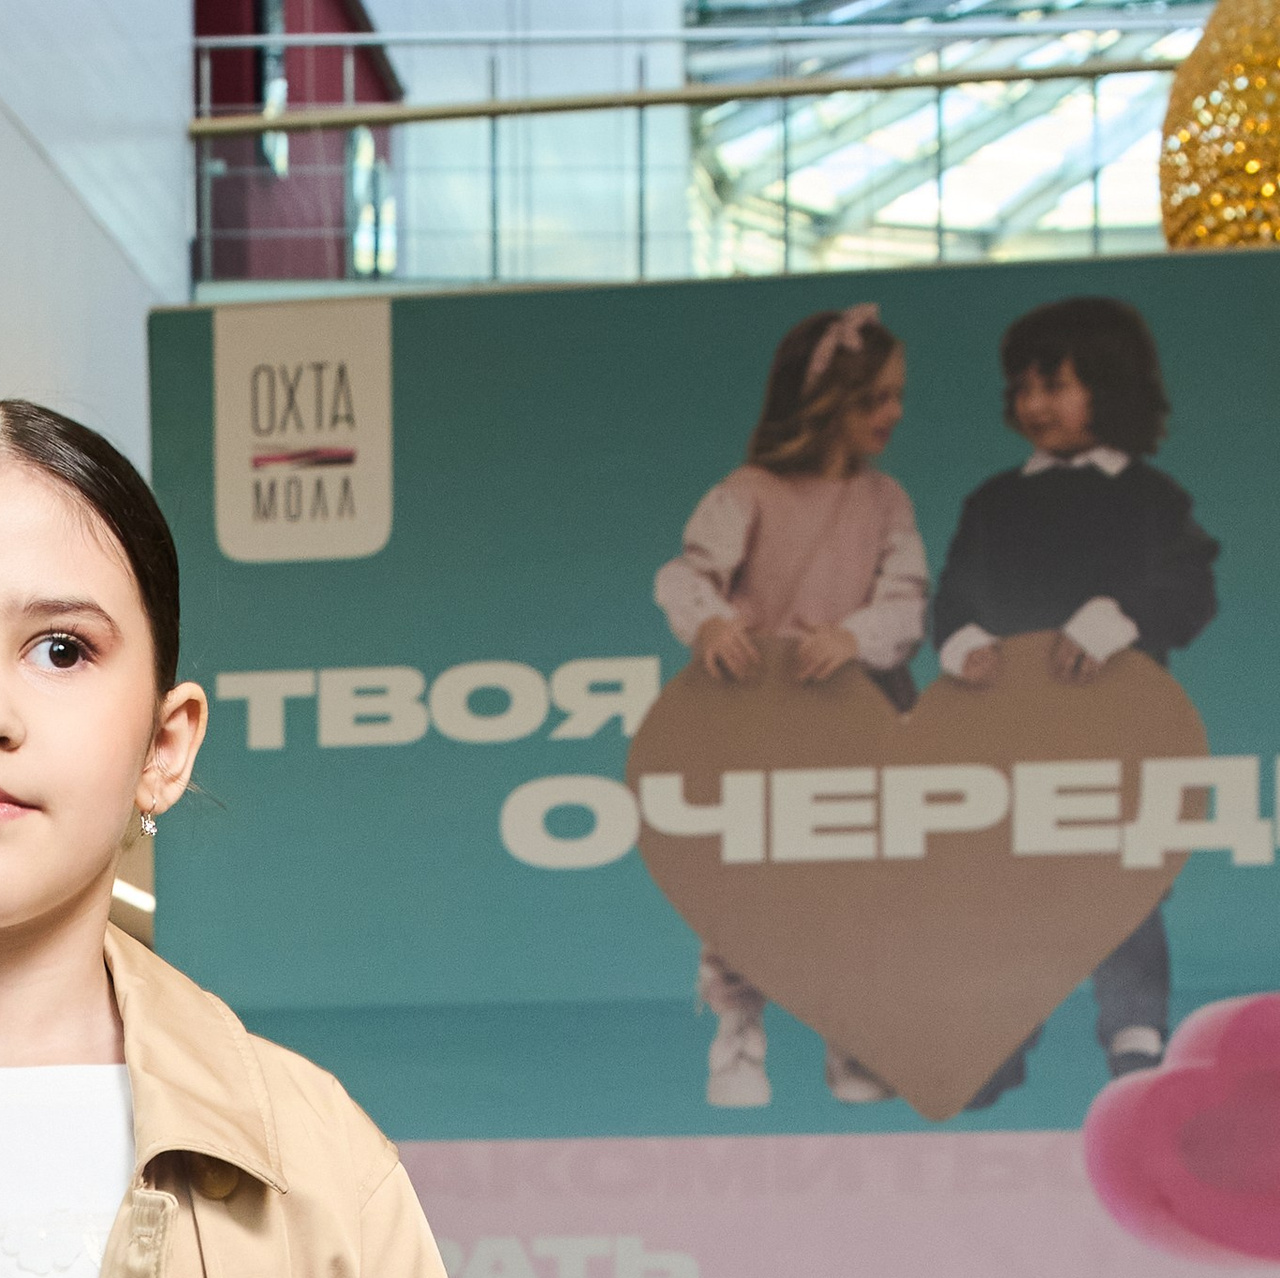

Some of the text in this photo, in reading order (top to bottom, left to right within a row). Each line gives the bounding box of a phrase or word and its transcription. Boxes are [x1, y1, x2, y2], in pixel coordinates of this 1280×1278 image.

[249, 360, 356, 436] ОХТА
[251, 474, 357, 523] МОЛЛ
[215, 654, 661, 751] ТВОЯ
[498, 754, 1280, 871] ОЧЕРЕД
